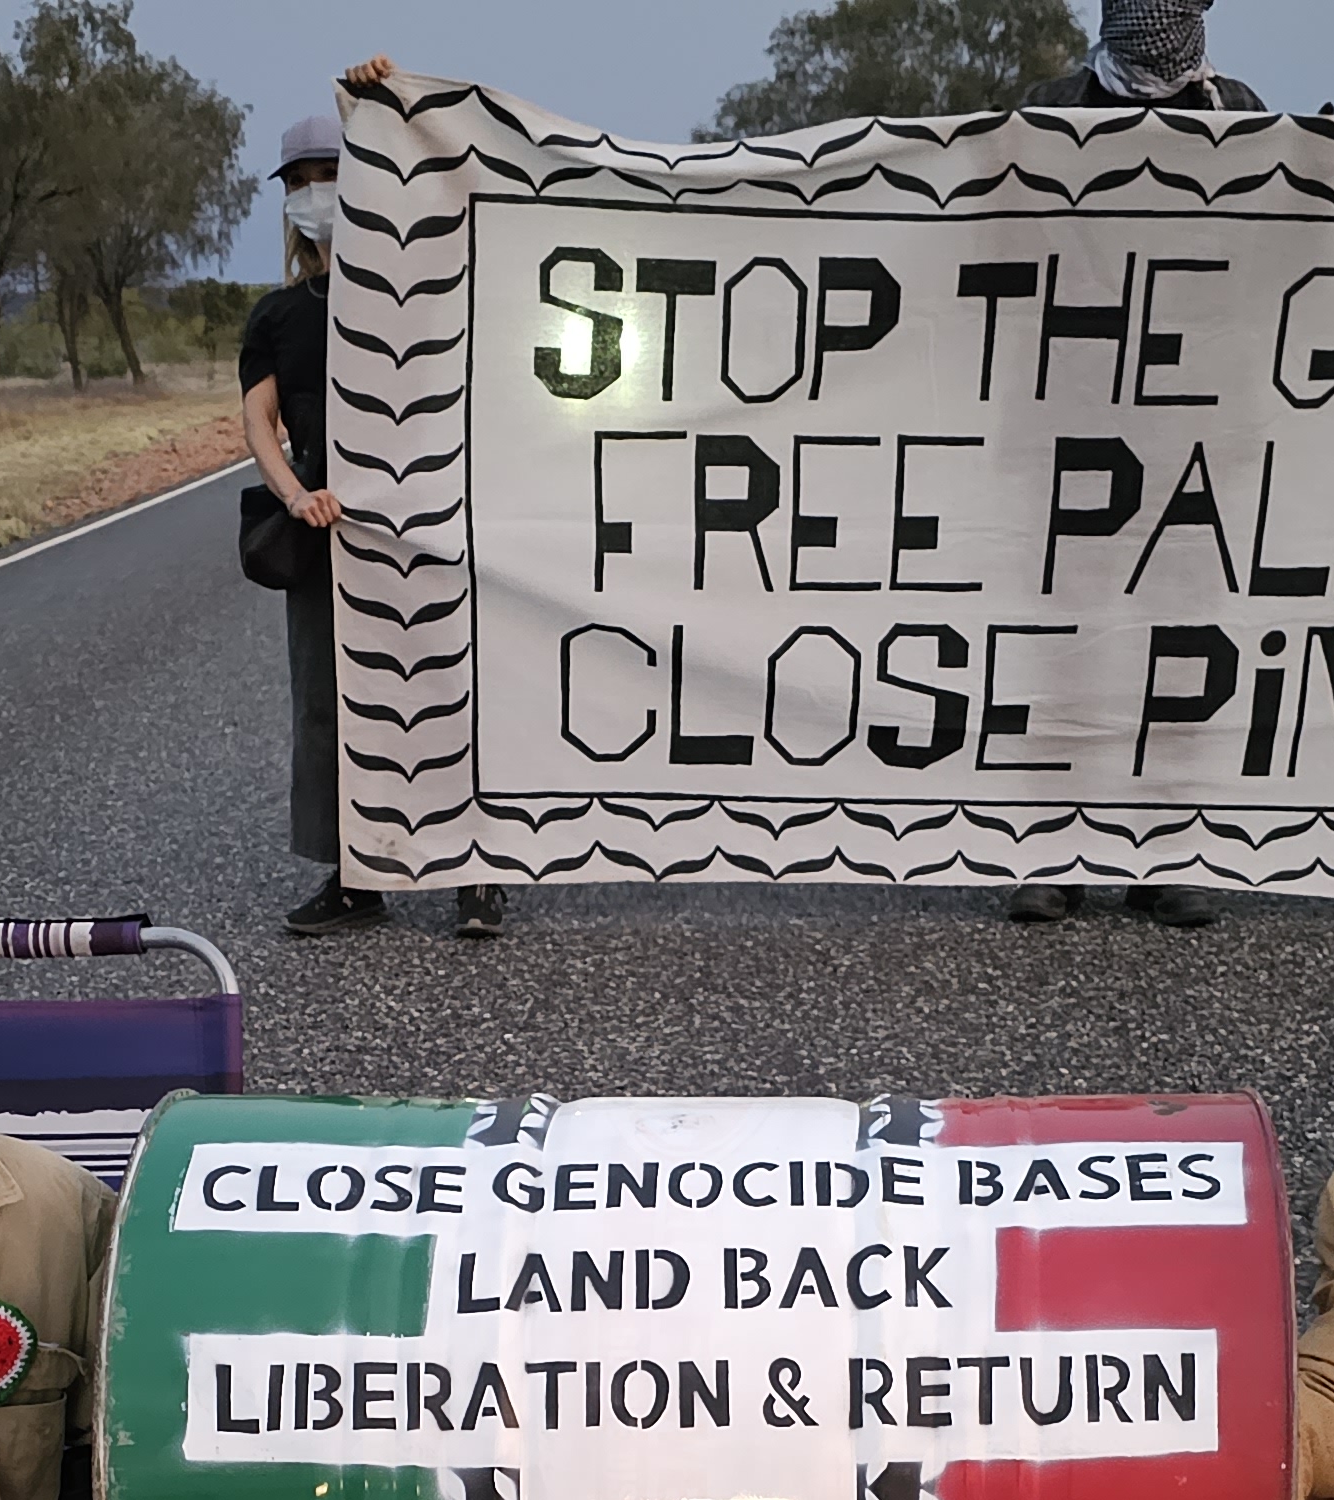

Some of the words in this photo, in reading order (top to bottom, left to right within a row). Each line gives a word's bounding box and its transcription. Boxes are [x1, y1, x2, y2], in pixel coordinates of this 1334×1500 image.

[533, 246, 902, 404] STOP
[956, 251, 1230, 407] THE
[593, 430, 985, 593] FREE
[560, 622, 1079, 772] CLOSE
[202, 1164, 467, 1214] CLOSE
[492, 1156, 925, 1214] GENOCIDE
[957, 1152, 1222, 1206] BASES
[456, 1249, 691, 1314] LAND
[723, 1243, 953, 1310] BACK
[215, 1359, 731, 1435] LIBERATION
[762, 1357, 819, 1429] &
[848, 1352, 1196, 1430] RETURN
